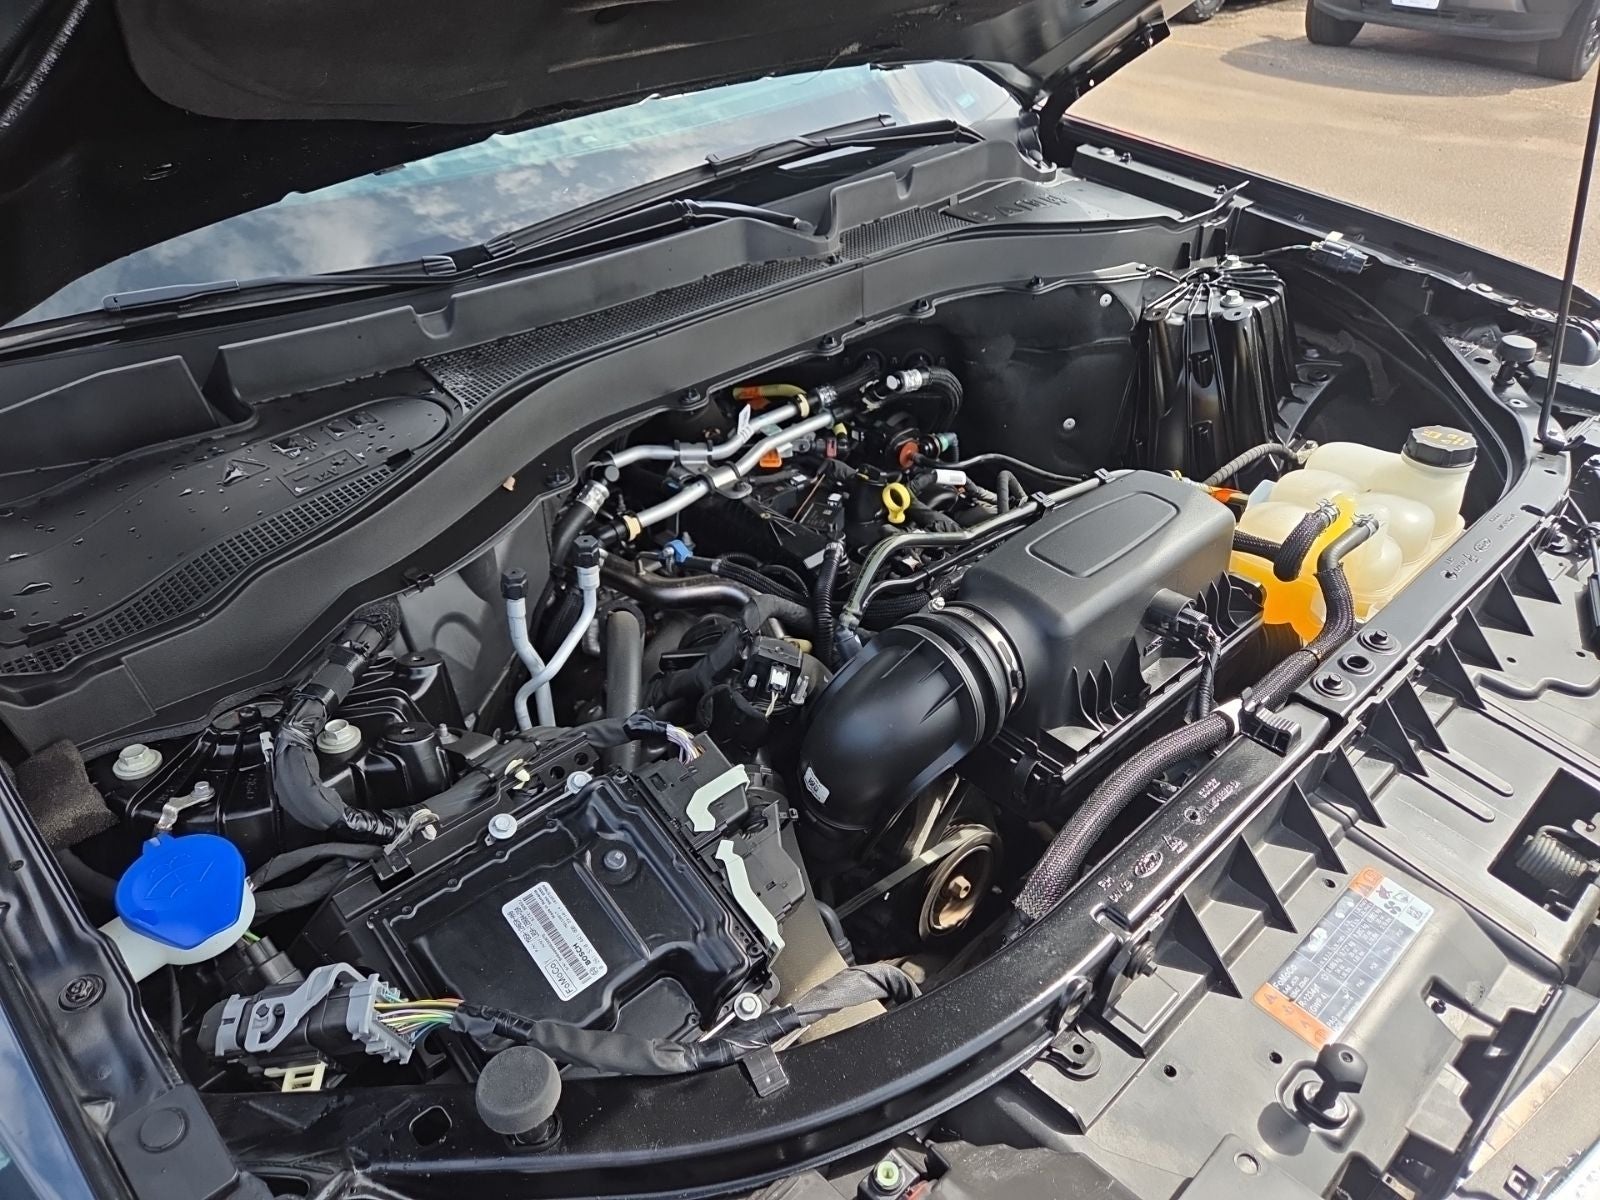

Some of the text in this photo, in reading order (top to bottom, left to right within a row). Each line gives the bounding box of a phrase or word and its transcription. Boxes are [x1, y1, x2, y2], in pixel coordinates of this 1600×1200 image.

[573, 943, 591, 966] BOSCH
[549, 962, 575, 994] FoMoCo
[1272, 963, 1297, 988] FoMoCo
